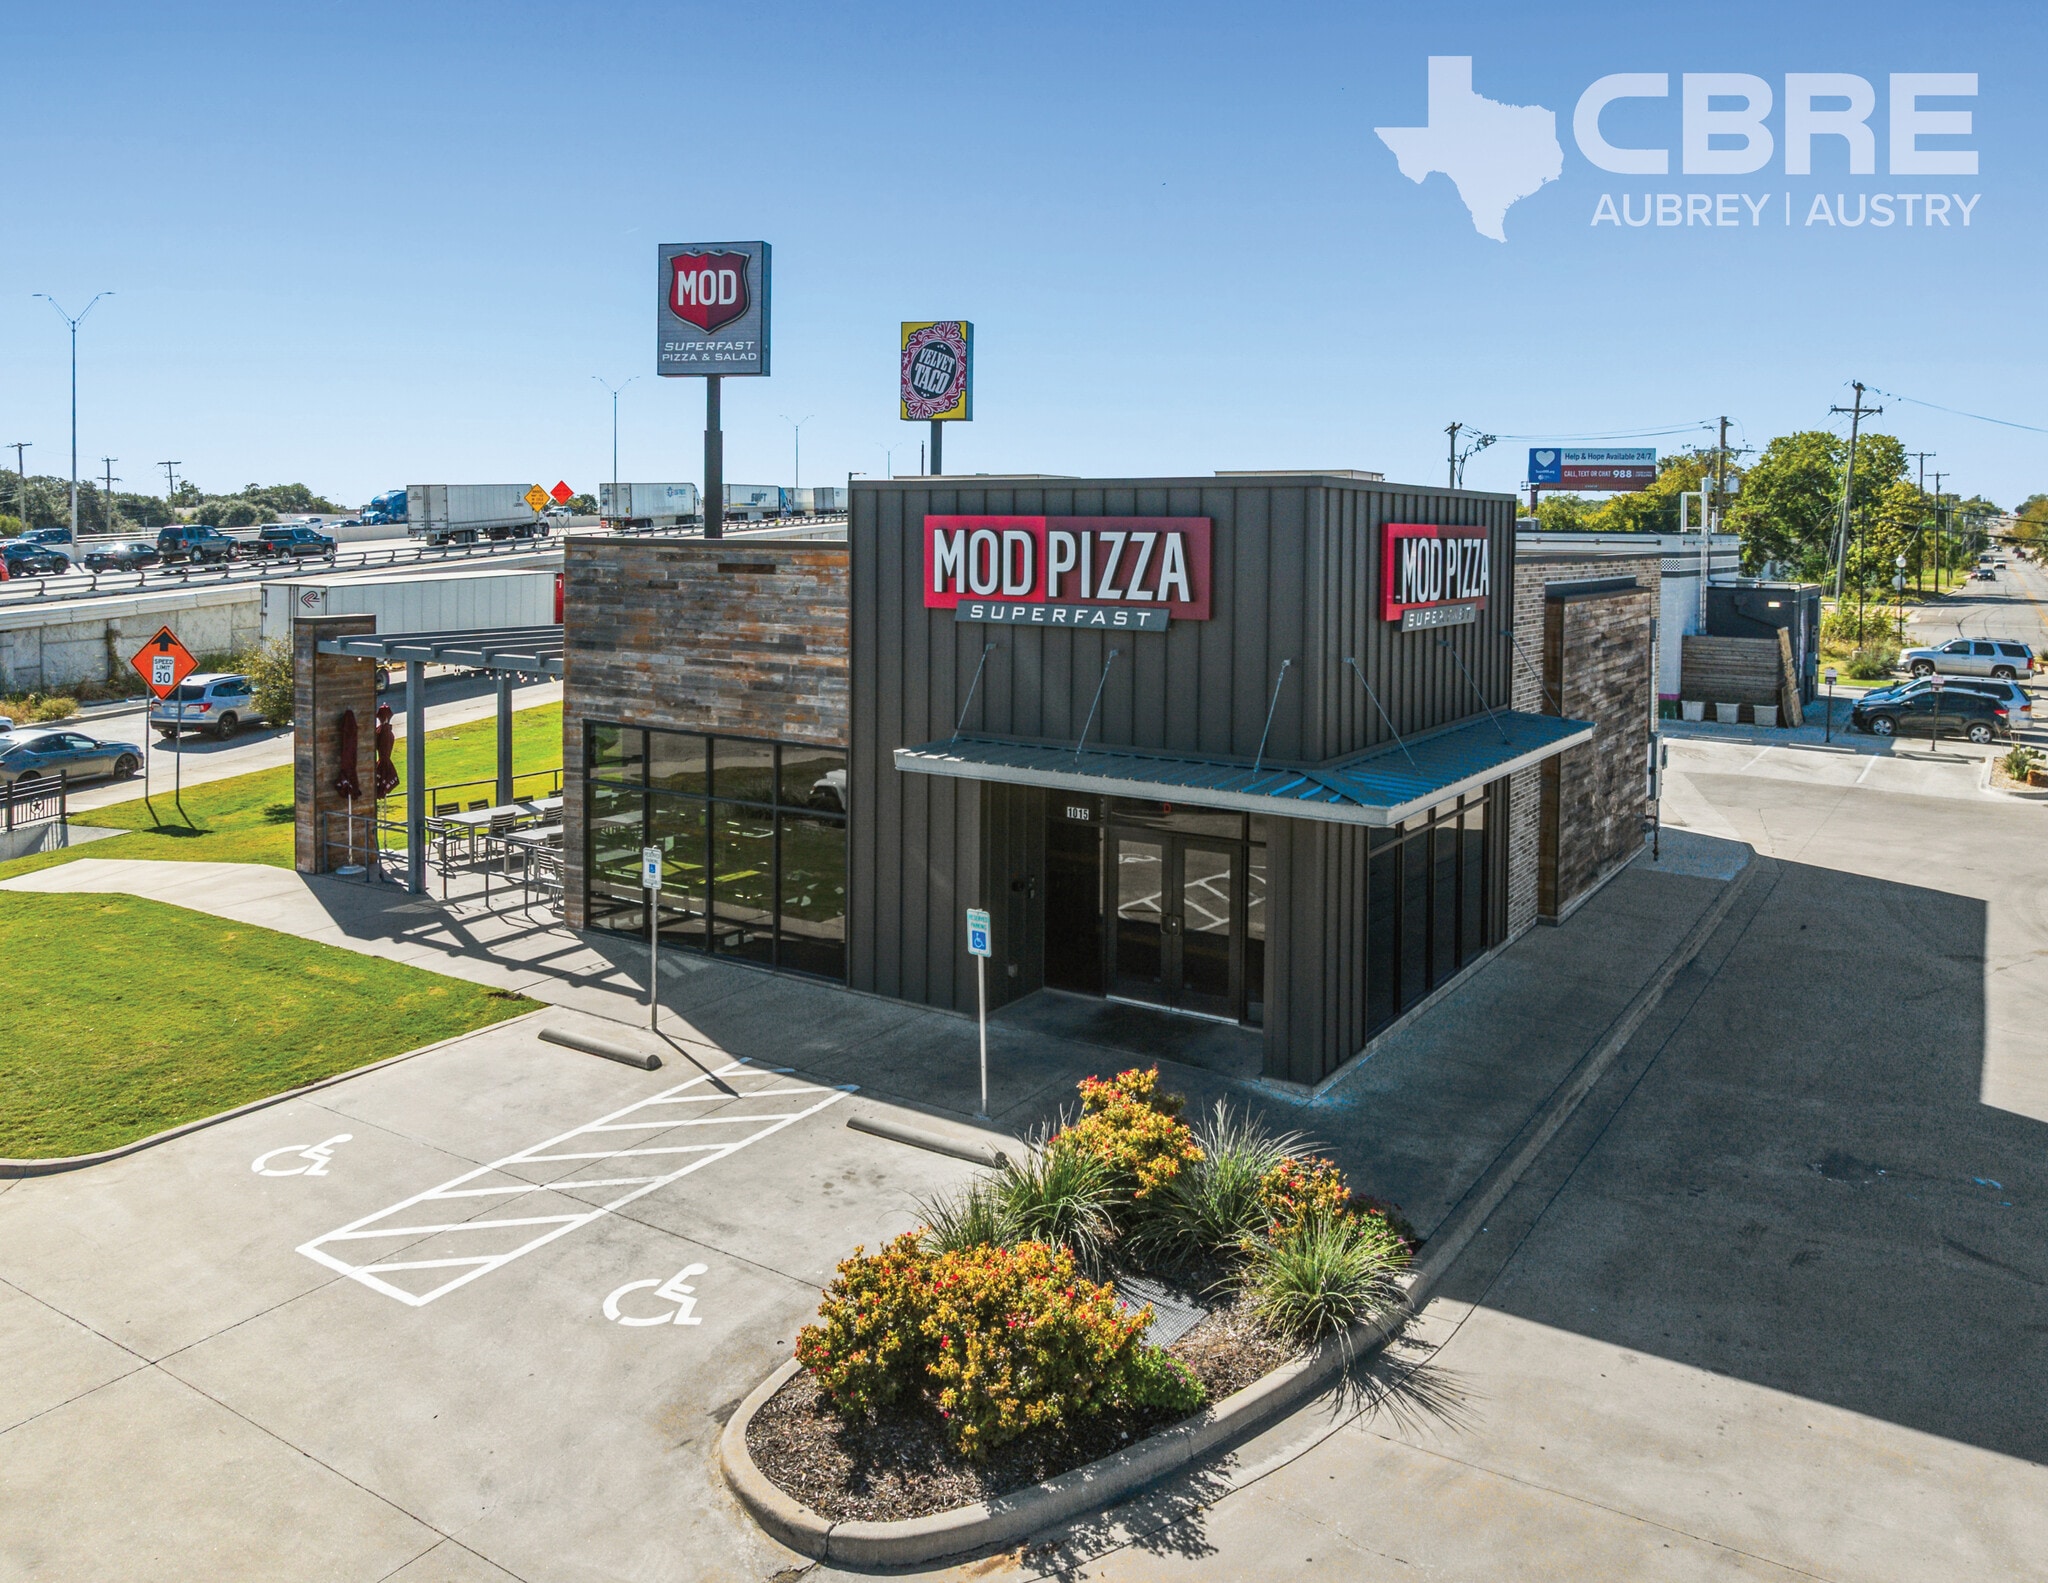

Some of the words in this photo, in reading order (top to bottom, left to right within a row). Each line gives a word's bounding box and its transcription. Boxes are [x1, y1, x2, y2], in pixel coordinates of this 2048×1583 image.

[677, 269, 737, 306] MOD
[664, 341, 755, 351] SUPERFAST
[662, 353, 698, 362] PIZZA
[701, 353, 711, 362] &
[714, 353, 757, 361] SALAD
[919, 348, 955, 373] VELVET
[914, 363, 950, 394] TACO
[1565, 452, 1579, 461] Help
[1588, 452, 1604, 461] Hope
[1606, 452, 1634, 460] Available
[1612, 470, 1632, 478] 988
[933, 529, 1035, 598] MOD
[1048, 530, 1191, 602] PIZZA
[1401, 537, 1442, 604] MOD
[1446, 538, 1490, 600] PIZZA
[970, 604, 1151, 627] SUPERFAST
[1408, 607, 1471, 627] SUPERST
[155, 672, 171, 684] 30
[1067, 807, 1089, 820] 1015
